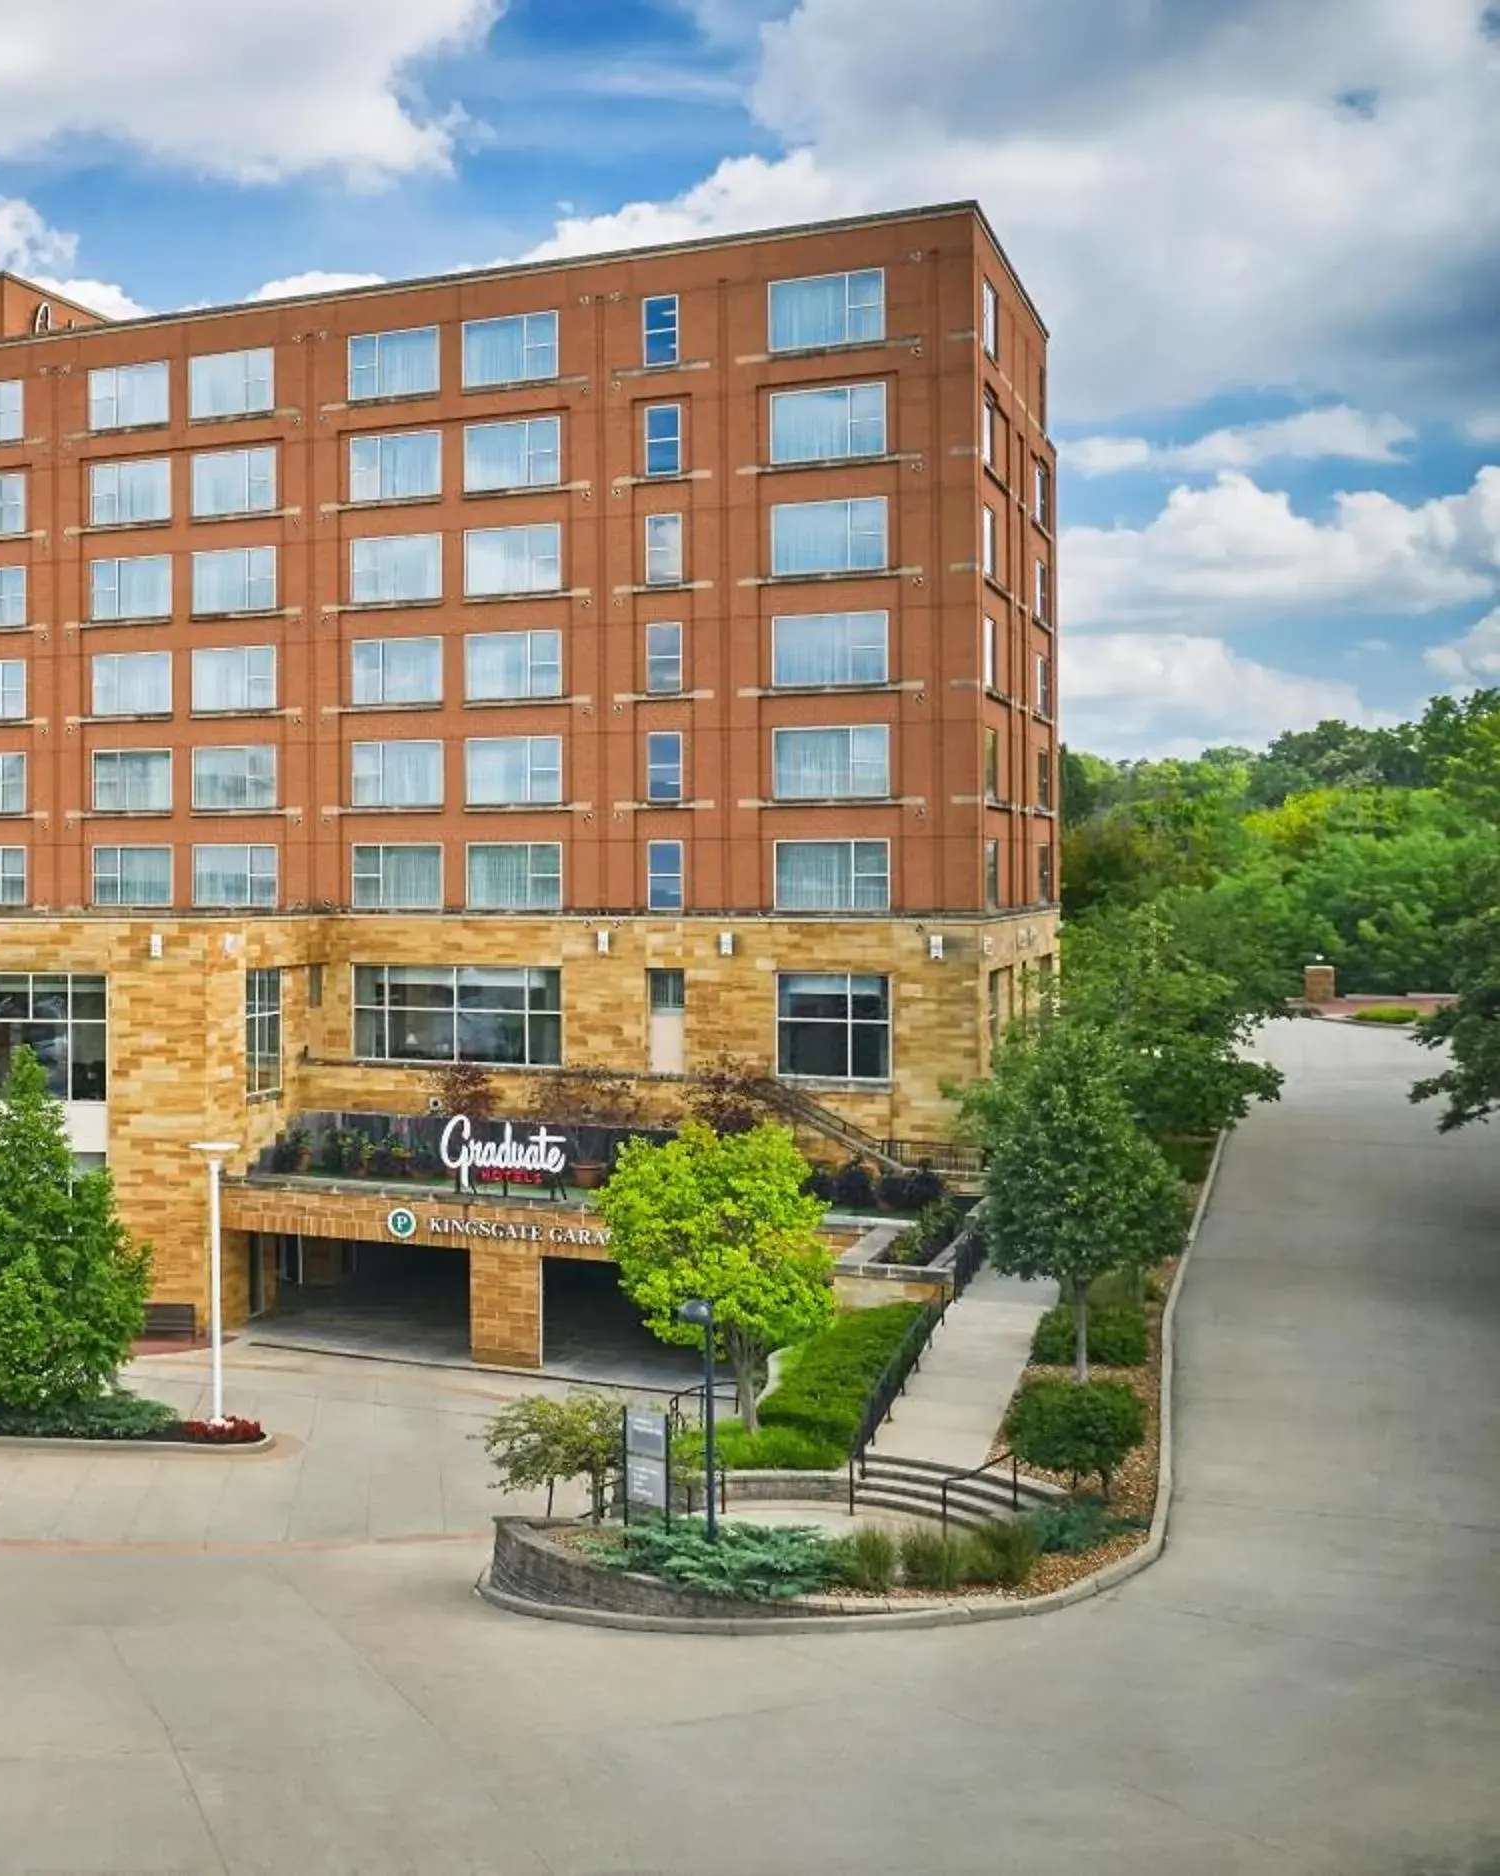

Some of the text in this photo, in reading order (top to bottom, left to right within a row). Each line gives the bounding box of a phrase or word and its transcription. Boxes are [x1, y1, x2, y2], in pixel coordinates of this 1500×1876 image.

[440, 1114, 567, 1187] Graduate
[480, 1169, 543, 1184] HOTELS
[430, 1217, 544, 1241] KINGSGATE
